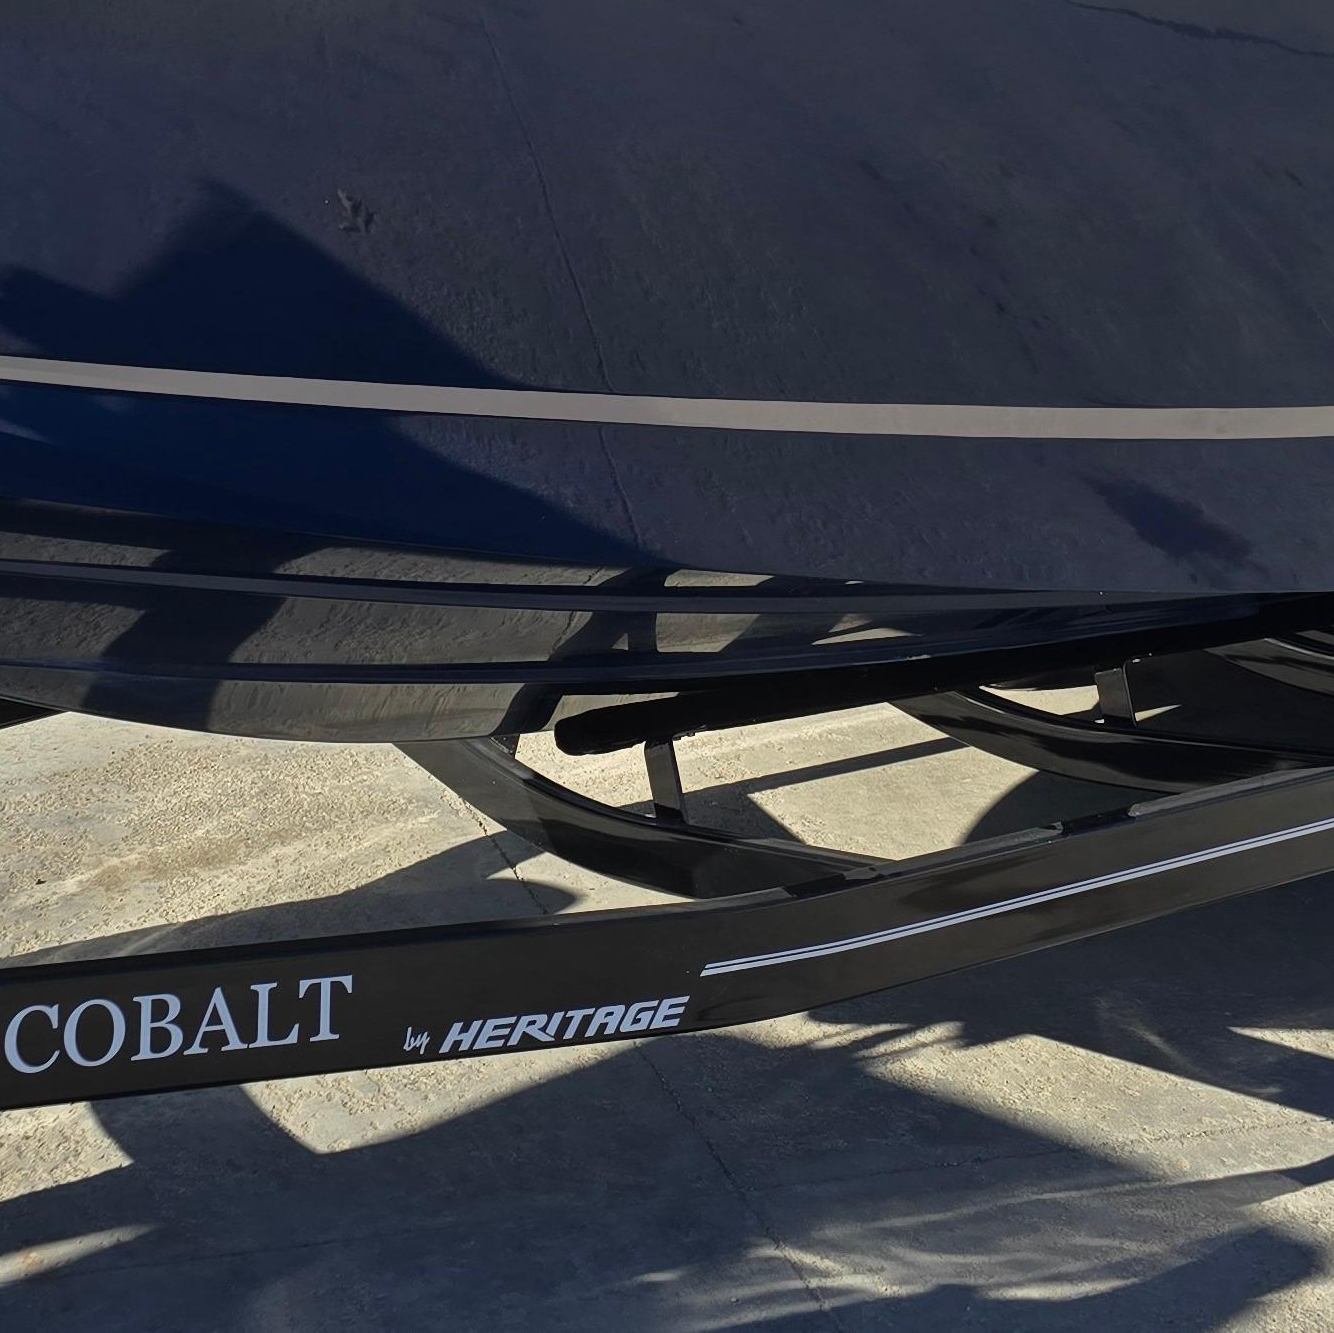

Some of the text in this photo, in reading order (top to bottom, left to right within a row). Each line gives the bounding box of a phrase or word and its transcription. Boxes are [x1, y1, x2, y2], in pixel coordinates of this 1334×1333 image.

[3, 974, 691, 1075] COBALT by HERITAGE
